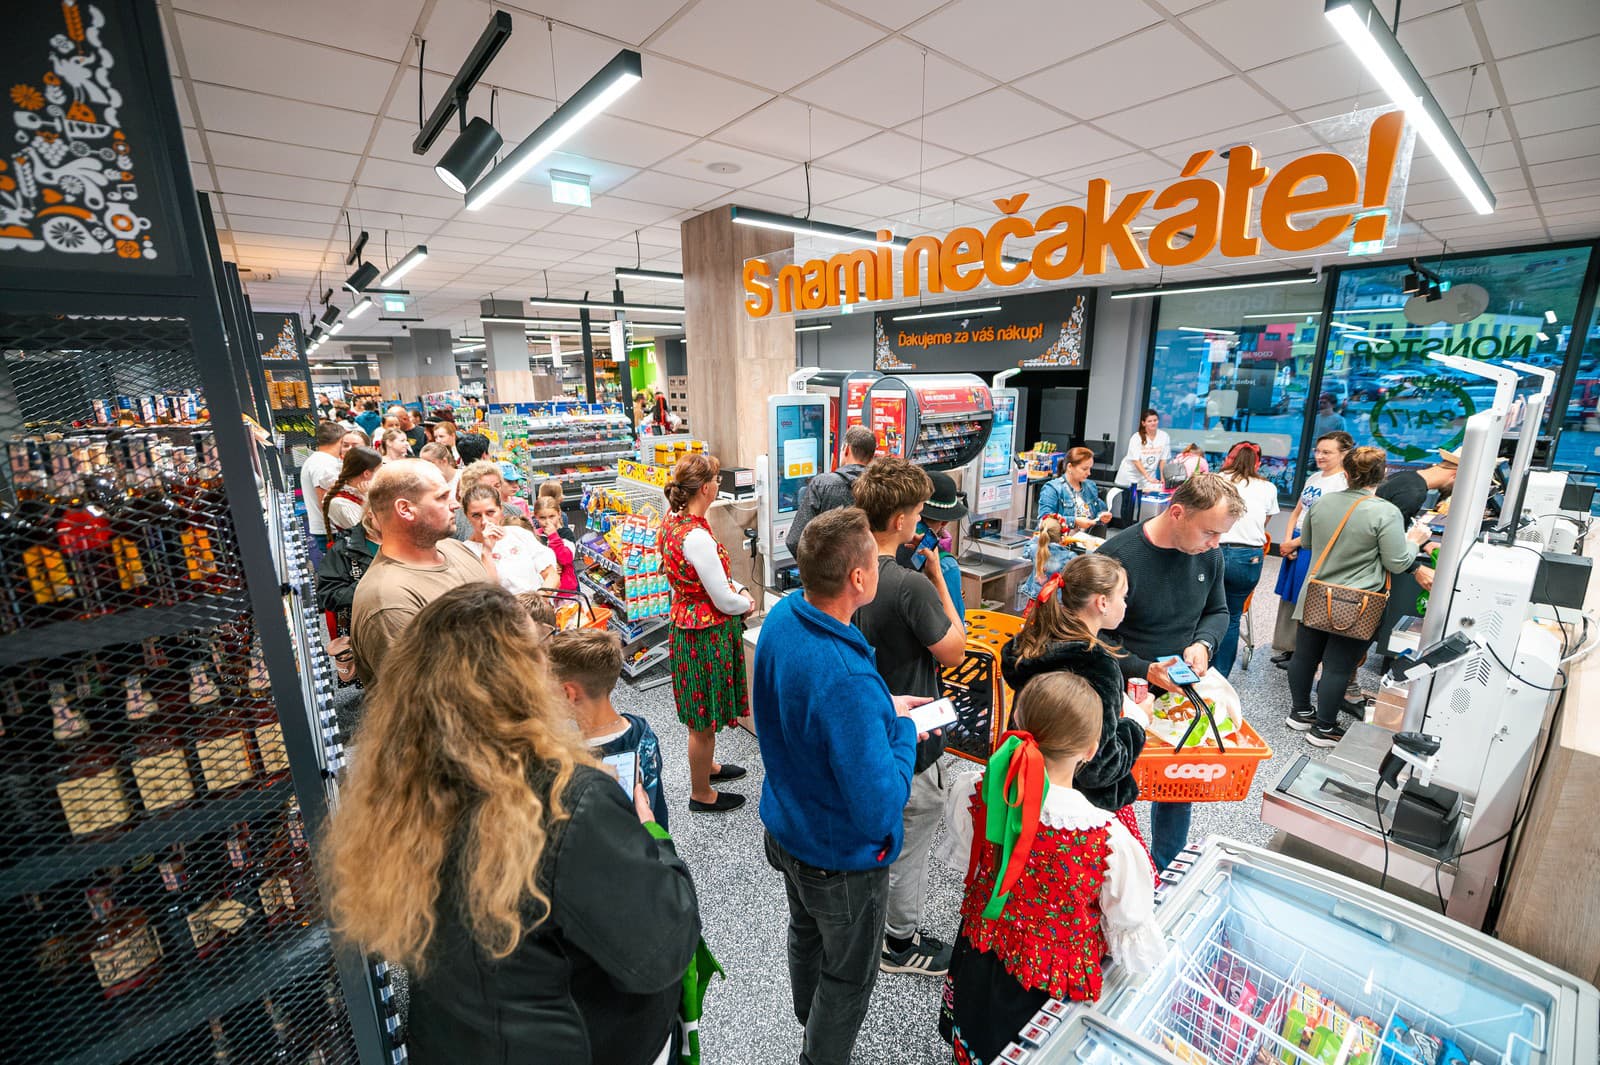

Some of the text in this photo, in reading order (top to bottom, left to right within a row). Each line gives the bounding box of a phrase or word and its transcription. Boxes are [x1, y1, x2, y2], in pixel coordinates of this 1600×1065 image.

[742, 113, 1401, 317] S nami nečakáte!
[898, 322, 1044, 349] Ďakujeme za váš nákup!
[1164, 763, 1226, 782] coop
